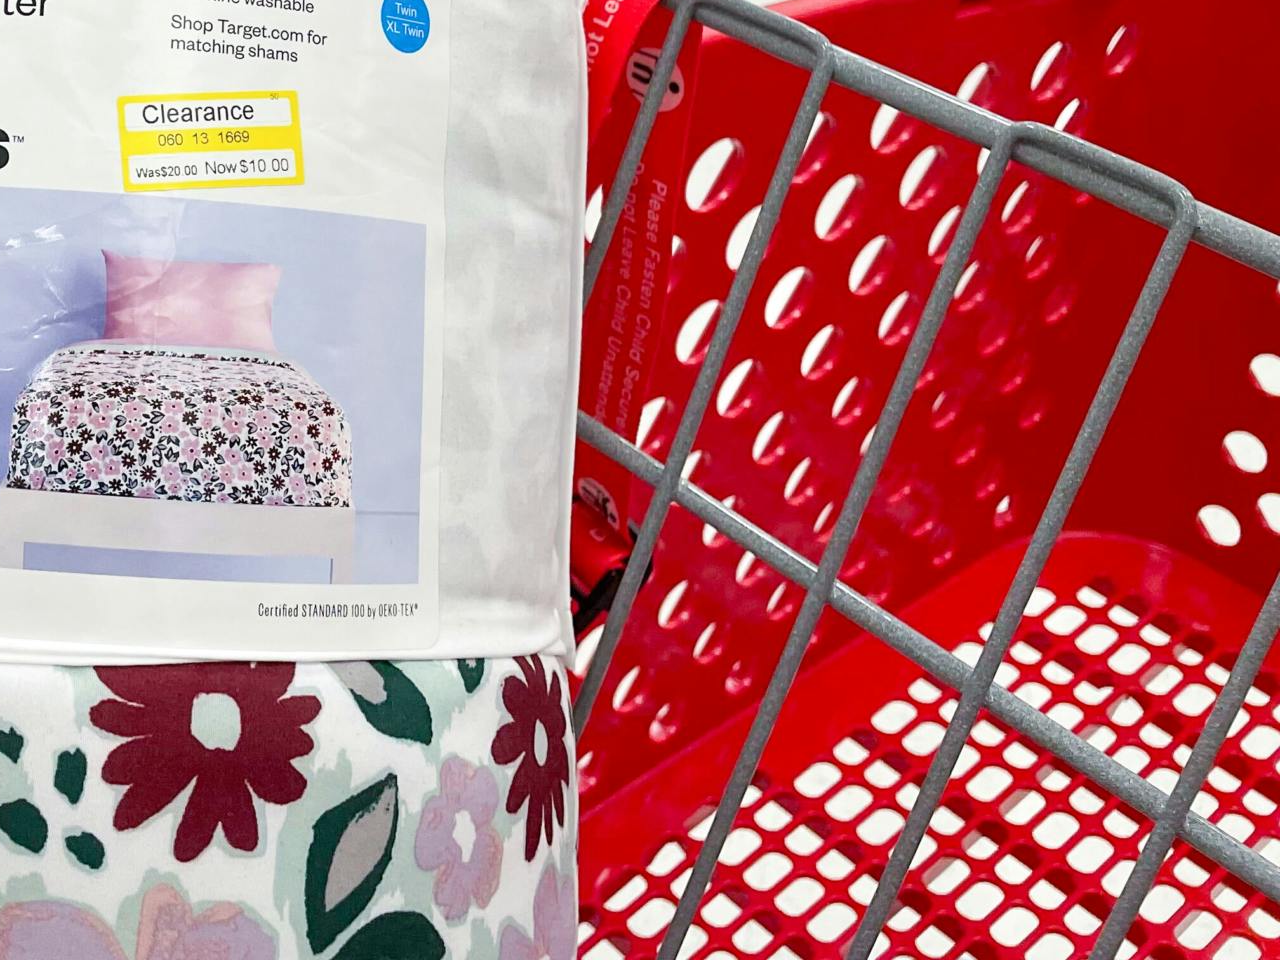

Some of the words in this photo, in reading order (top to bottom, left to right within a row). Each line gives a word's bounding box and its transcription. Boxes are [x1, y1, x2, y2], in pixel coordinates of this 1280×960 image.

[394, 2, 417, 18] Twin
[171, 14, 214, 35] Shop
[217, 19, 304, 43] Target.com
[307, 28, 328, 46] for
[386, 20, 401, 34] XL
[402, 23, 425, 39] Twin
[170, 37, 245, 60] matching
[248, 42, 298, 63] shams
[141, 103, 255, 125] Clearance
[157, 132, 184, 147] 060
[192, 132, 210, 146] 13
[217, 130, 251, 145] 1669
[205, 161, 238, 176] Now
[646, 178, 668, 243] Please
[619, 226, 637, 279] Leave
[640, 246, 661, 309] Fasten
[611, 284, 632, 334] Child
[628, 314, 651, 365] Child
[257, 602, 299, 618] Certified
[301, 603, 348, 618] STANDARD
[351, 604, 365, 618] 100
[367, 603, 377, 620] by
